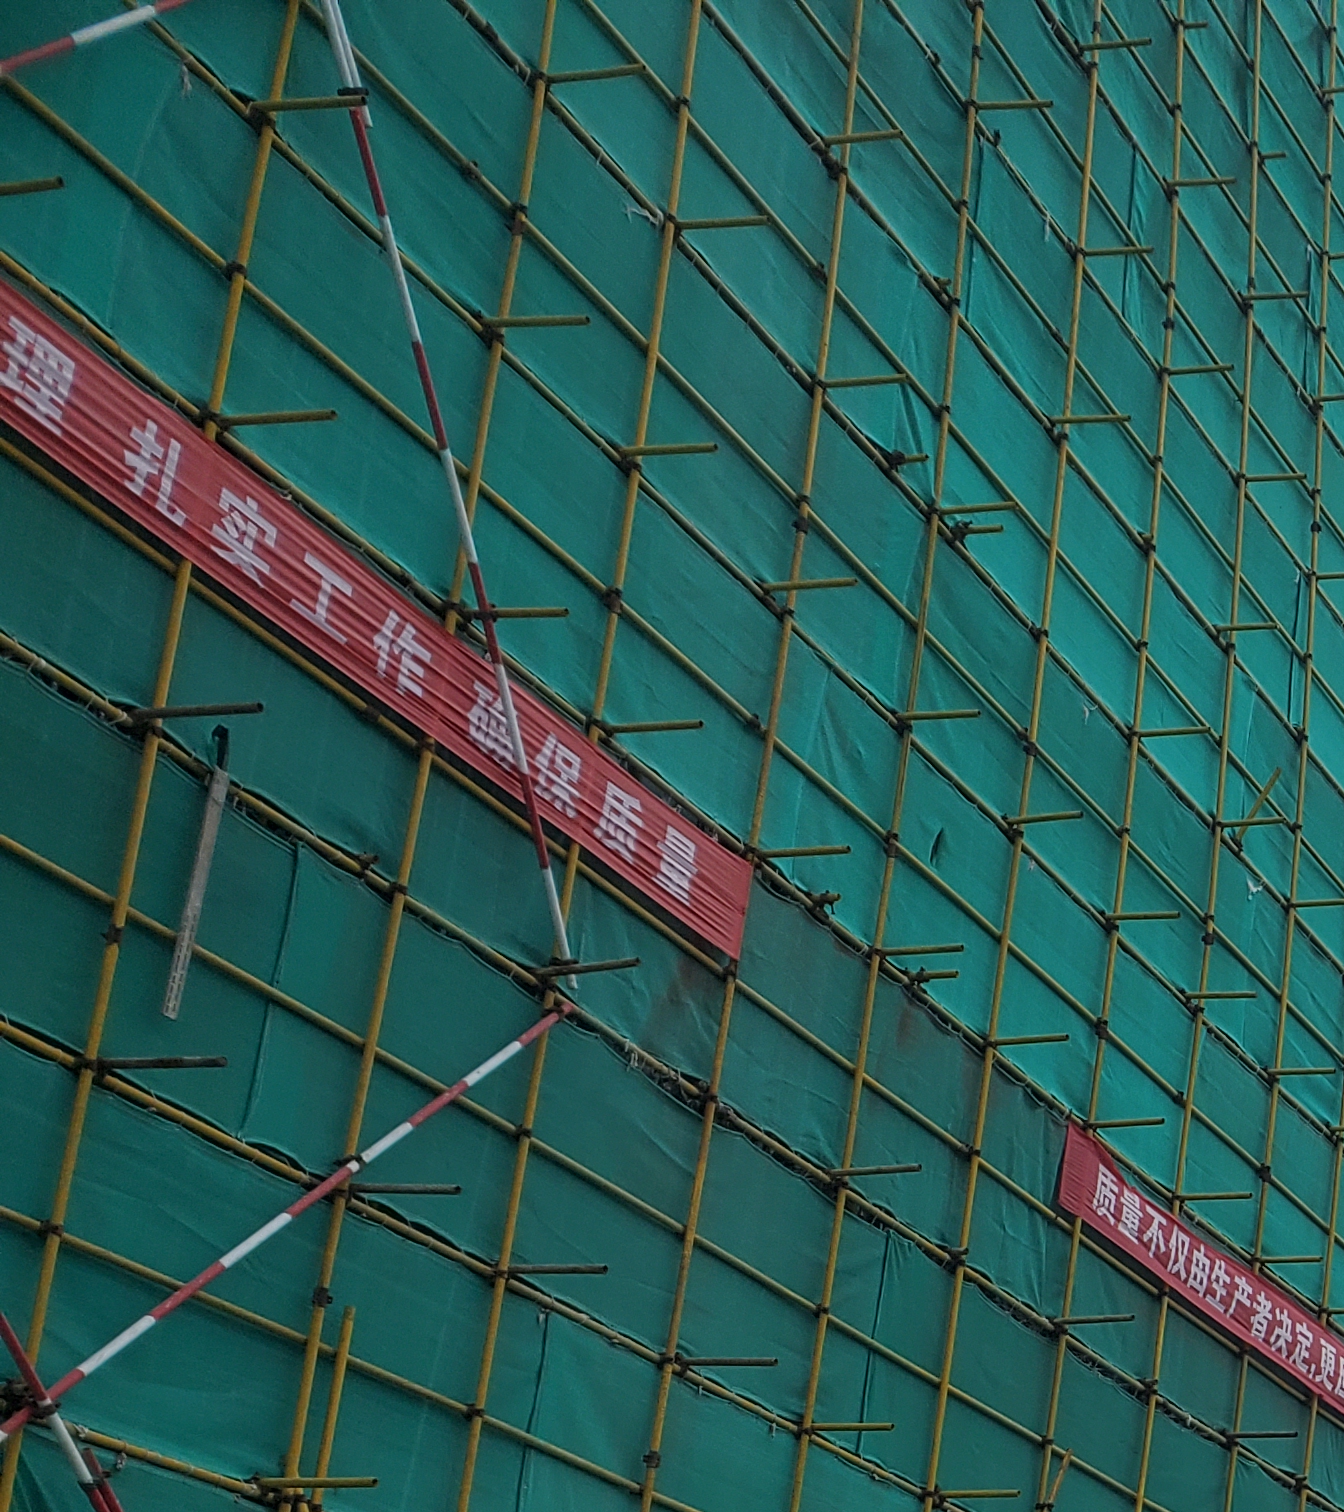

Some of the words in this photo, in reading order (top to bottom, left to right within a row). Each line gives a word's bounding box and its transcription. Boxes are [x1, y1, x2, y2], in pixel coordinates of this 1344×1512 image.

[0, 316, 75, 436] 理
[123, 419, 432, 698] 扎实工作
